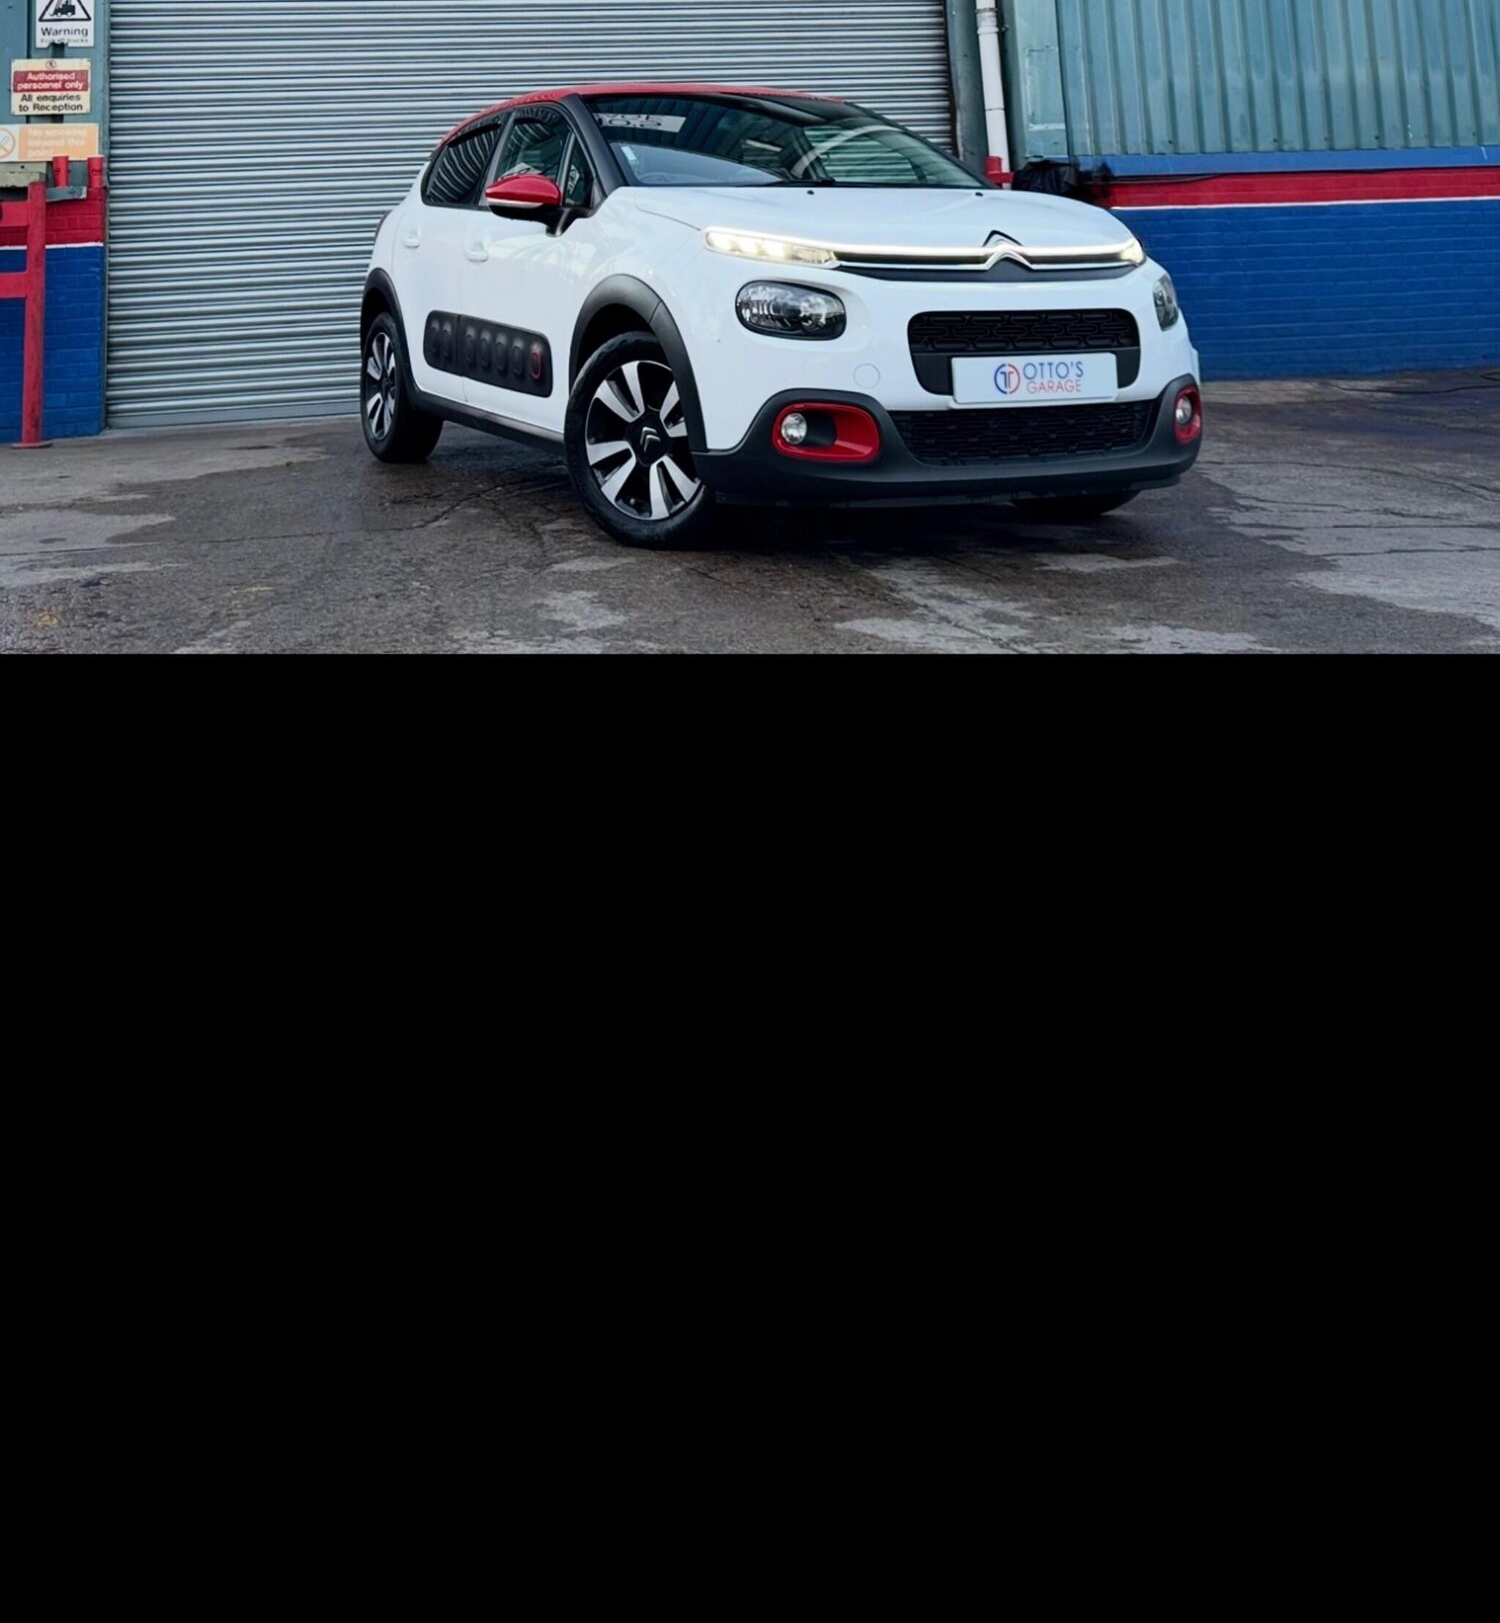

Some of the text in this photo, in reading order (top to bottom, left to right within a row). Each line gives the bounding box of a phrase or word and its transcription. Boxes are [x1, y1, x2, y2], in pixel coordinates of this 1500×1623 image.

[40, 27, 88, 37] Warning
[26, 72, 75, 80] Authorised
[64, 80, 84, 90] only
[21, 93, 81, 103] All enquiries
[19, 103, 83, 112] to Reception
[1023, 361, 1084, 380] OTTO'S
[1027, 379, 1082, 394] GARAGE
